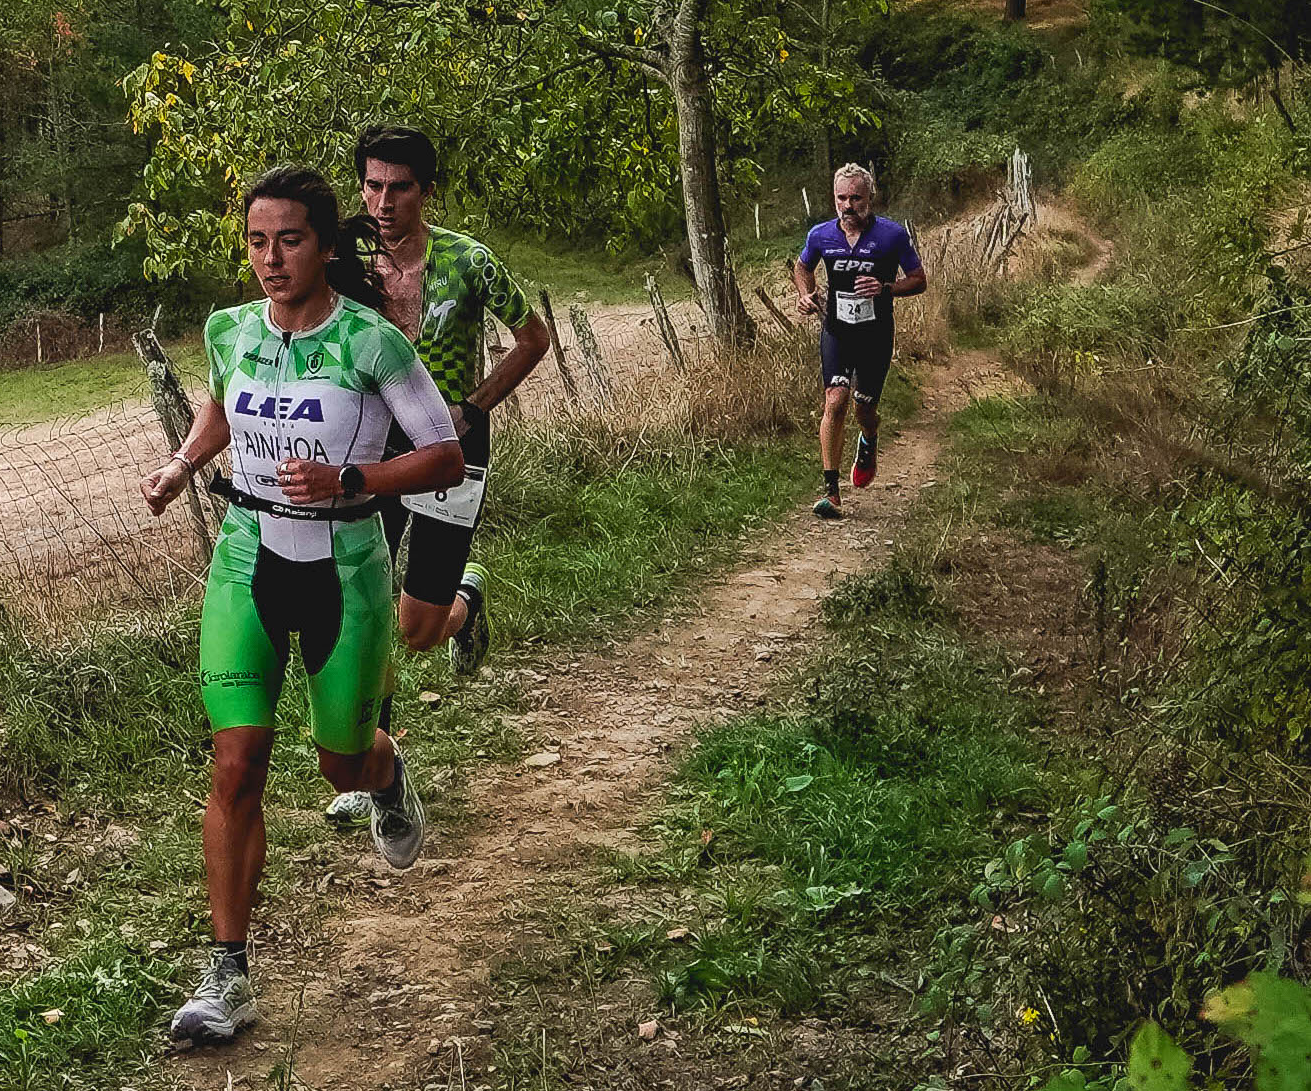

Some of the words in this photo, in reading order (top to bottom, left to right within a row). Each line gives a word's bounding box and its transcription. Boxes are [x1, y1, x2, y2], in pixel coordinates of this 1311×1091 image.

[847, 303, 861, 315] 24
[235, 391, 325, 423] LEA
[244, 430, 330, 465] AINHOA
